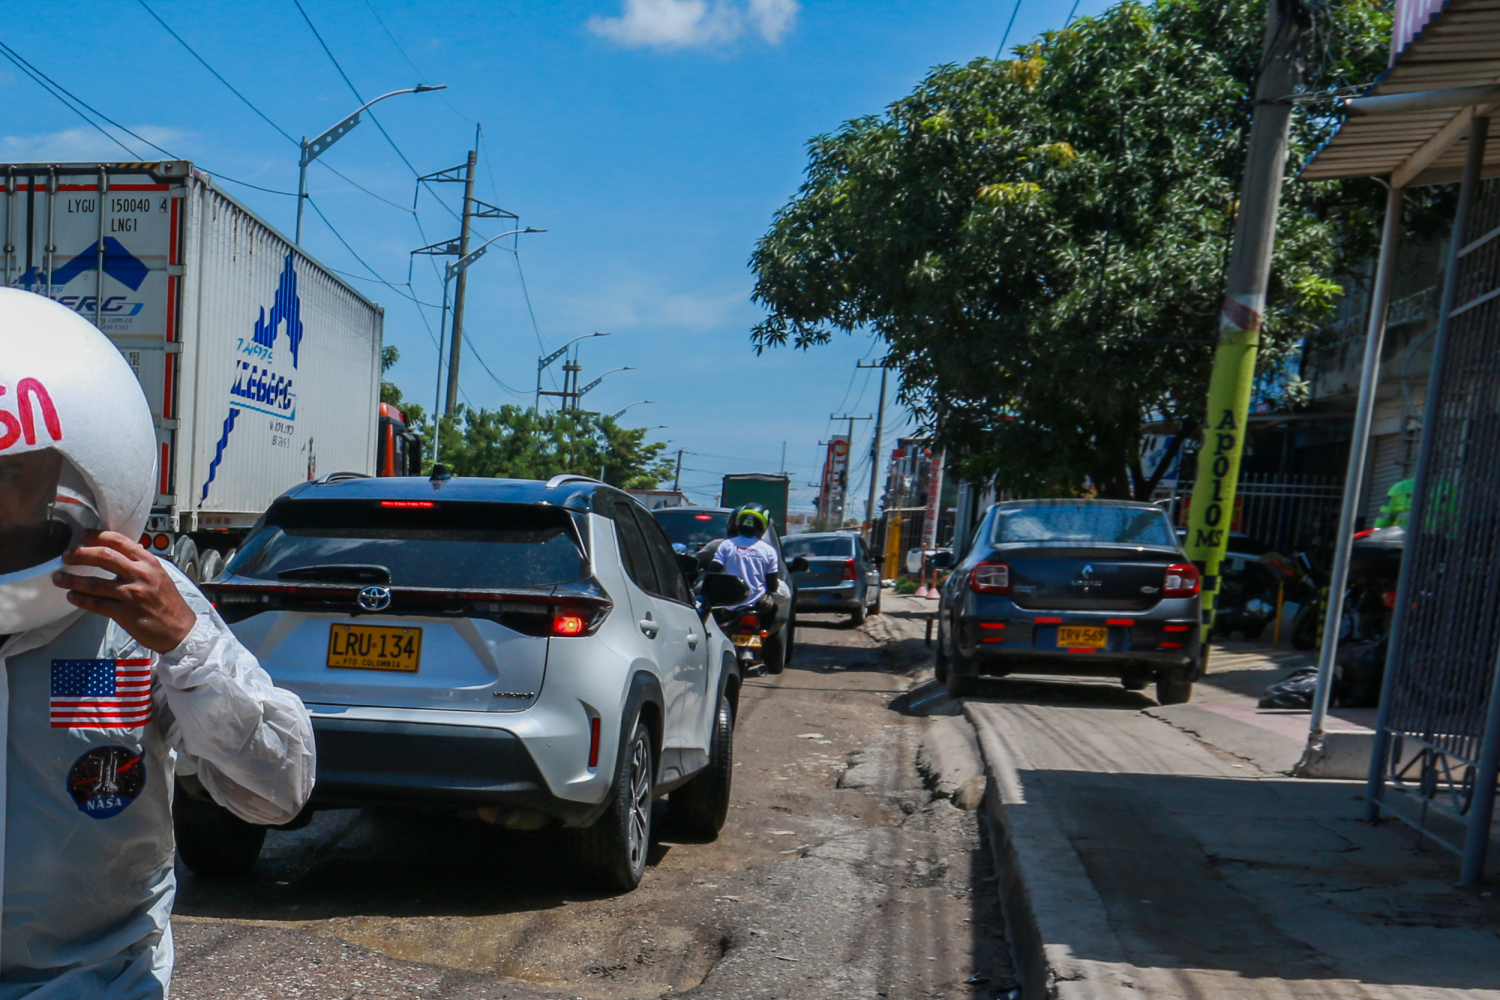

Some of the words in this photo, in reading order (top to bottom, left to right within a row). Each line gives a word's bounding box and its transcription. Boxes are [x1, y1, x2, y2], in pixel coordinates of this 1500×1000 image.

[68, 199, 94, 213] LYGU
[111, 199, 150, 213] 150040
[161, 198, 167, 213] 4
[111, 218, 137, 232] LNG1
[362, 659, 400, 668] COLOMBIA
[87, 798, 122, 811] NASA
